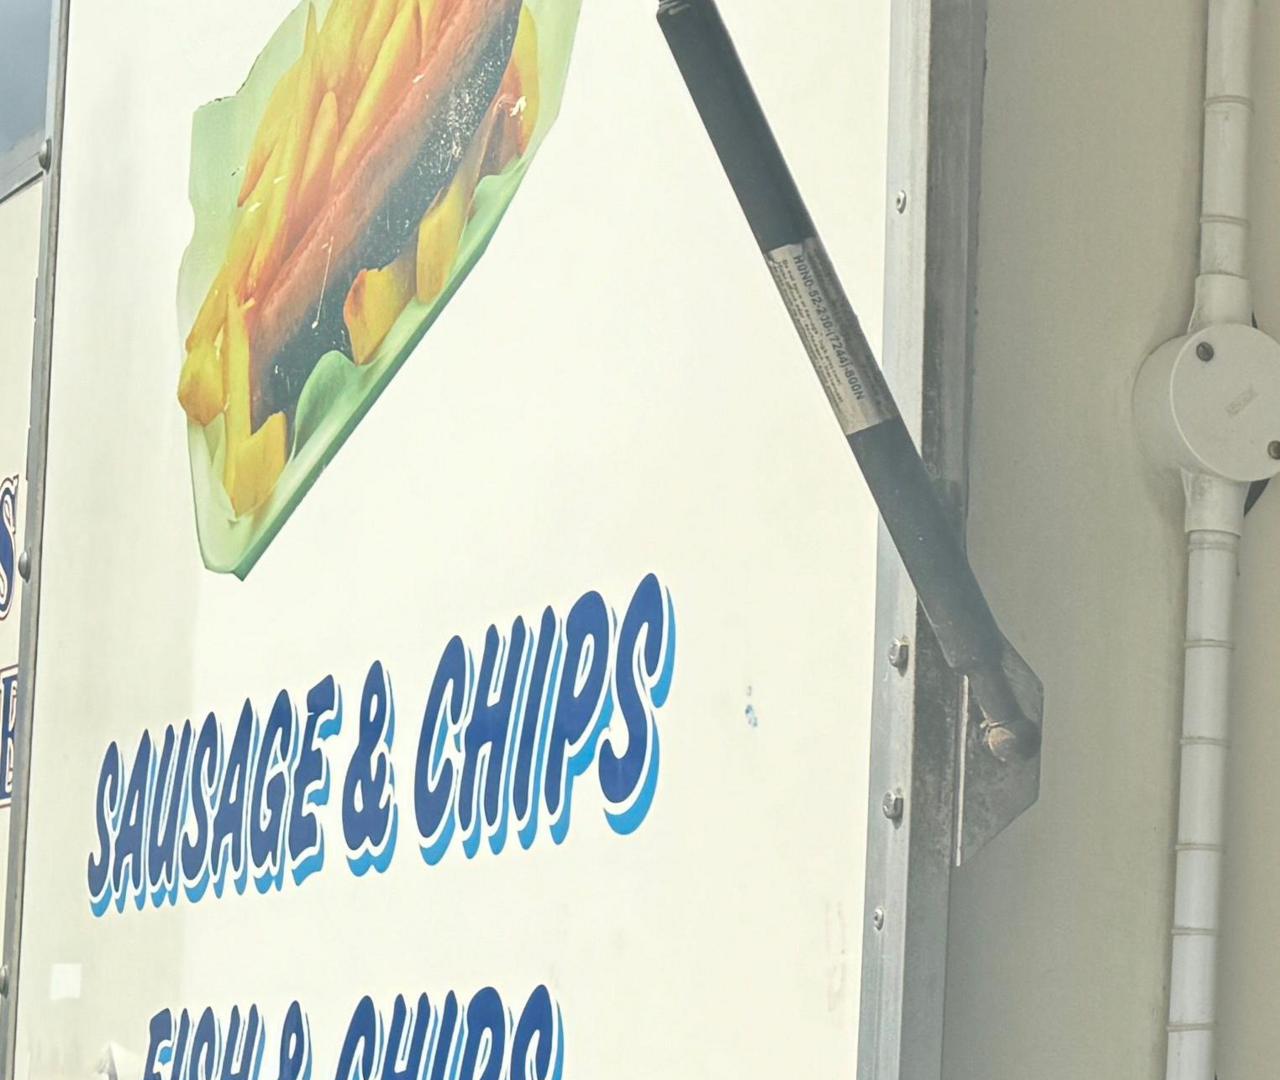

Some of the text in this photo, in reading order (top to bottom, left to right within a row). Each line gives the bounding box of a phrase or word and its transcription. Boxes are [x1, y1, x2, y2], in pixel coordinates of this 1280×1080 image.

[88, 674, 342, 917] SAUSAGE
[342, 660, 397, 876] &
[415, 572, 677, 866] CHIPS
